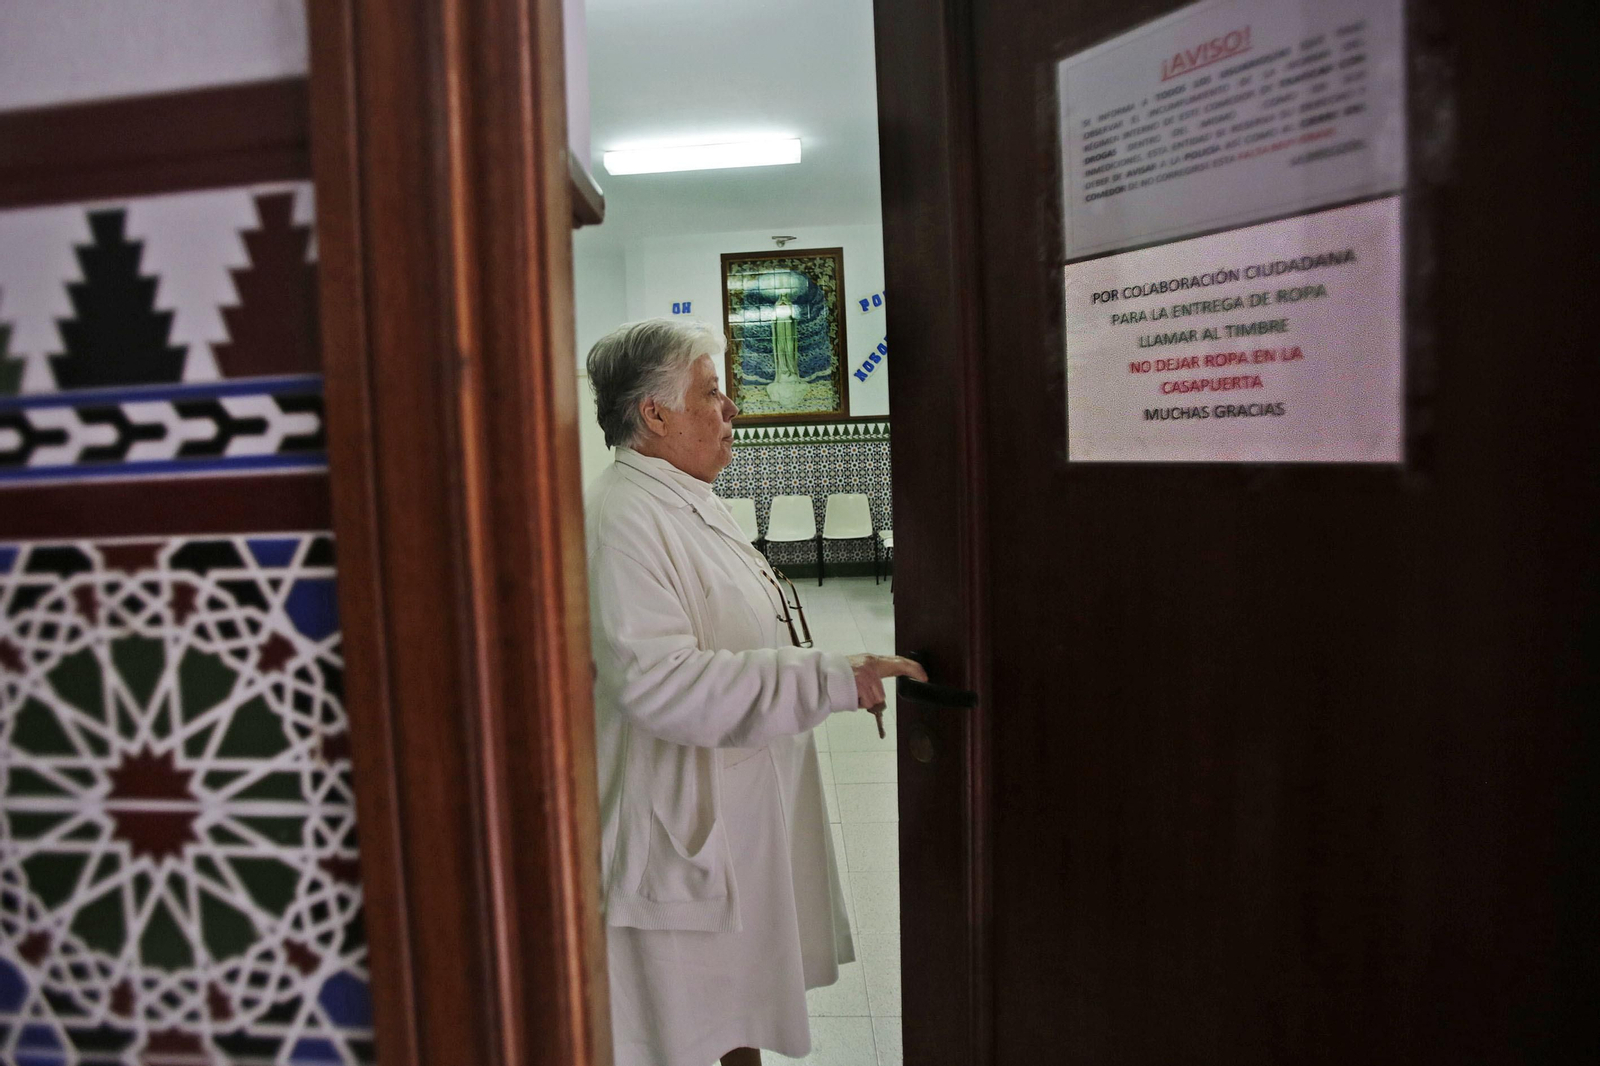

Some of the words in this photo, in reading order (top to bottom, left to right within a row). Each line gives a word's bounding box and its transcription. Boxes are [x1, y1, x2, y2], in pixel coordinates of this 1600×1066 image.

[1161, 26, 1252, 81] ¡AVISO!
[1154, 85, 1186, 102] TODOS
[1084, 149, 1117, 165] DROGAS
[1126, 163, 1156, 178] AVISAR
[1086, 186, 1126, 202] COMEDOR
[1093, 289, 1119, 304] POR
[1122, 267, 1240, 299] COLABORACIÓN
[1246, 249, 1356, 280] CIUDADANA
[859, 290, 886, 312] PO
[1112, 309, 1146, 325] PARA
[1152, 306, 1169, 321] LA
[1173, 296, 1243, 319] ENTREGA
[1250, 292, 1271, 308] DE
[1276, 284, 1327, 303] ROPA
[1138, 329, 1197, 348] LLAMAR
[1202, 325, 1221, 341] AL
[1225, 319, 1289, 338] TIMBRE
[854, 335, 888, 382] NOSO
[1129, 361, 1152, 374] NO
[1156, 357, 1199, 373] DEJAR
[1205, 352, 1247, 368] ROPA
[1254, 350, 1275, 364] EN
[1282, 346, 1304, 361] LA
[1161, 376, 1263, 394] CASAPUERTA
[1144, 406, 1209, 421] MUCHAS
[1215, 402, 1285, 419] GRACIAS
